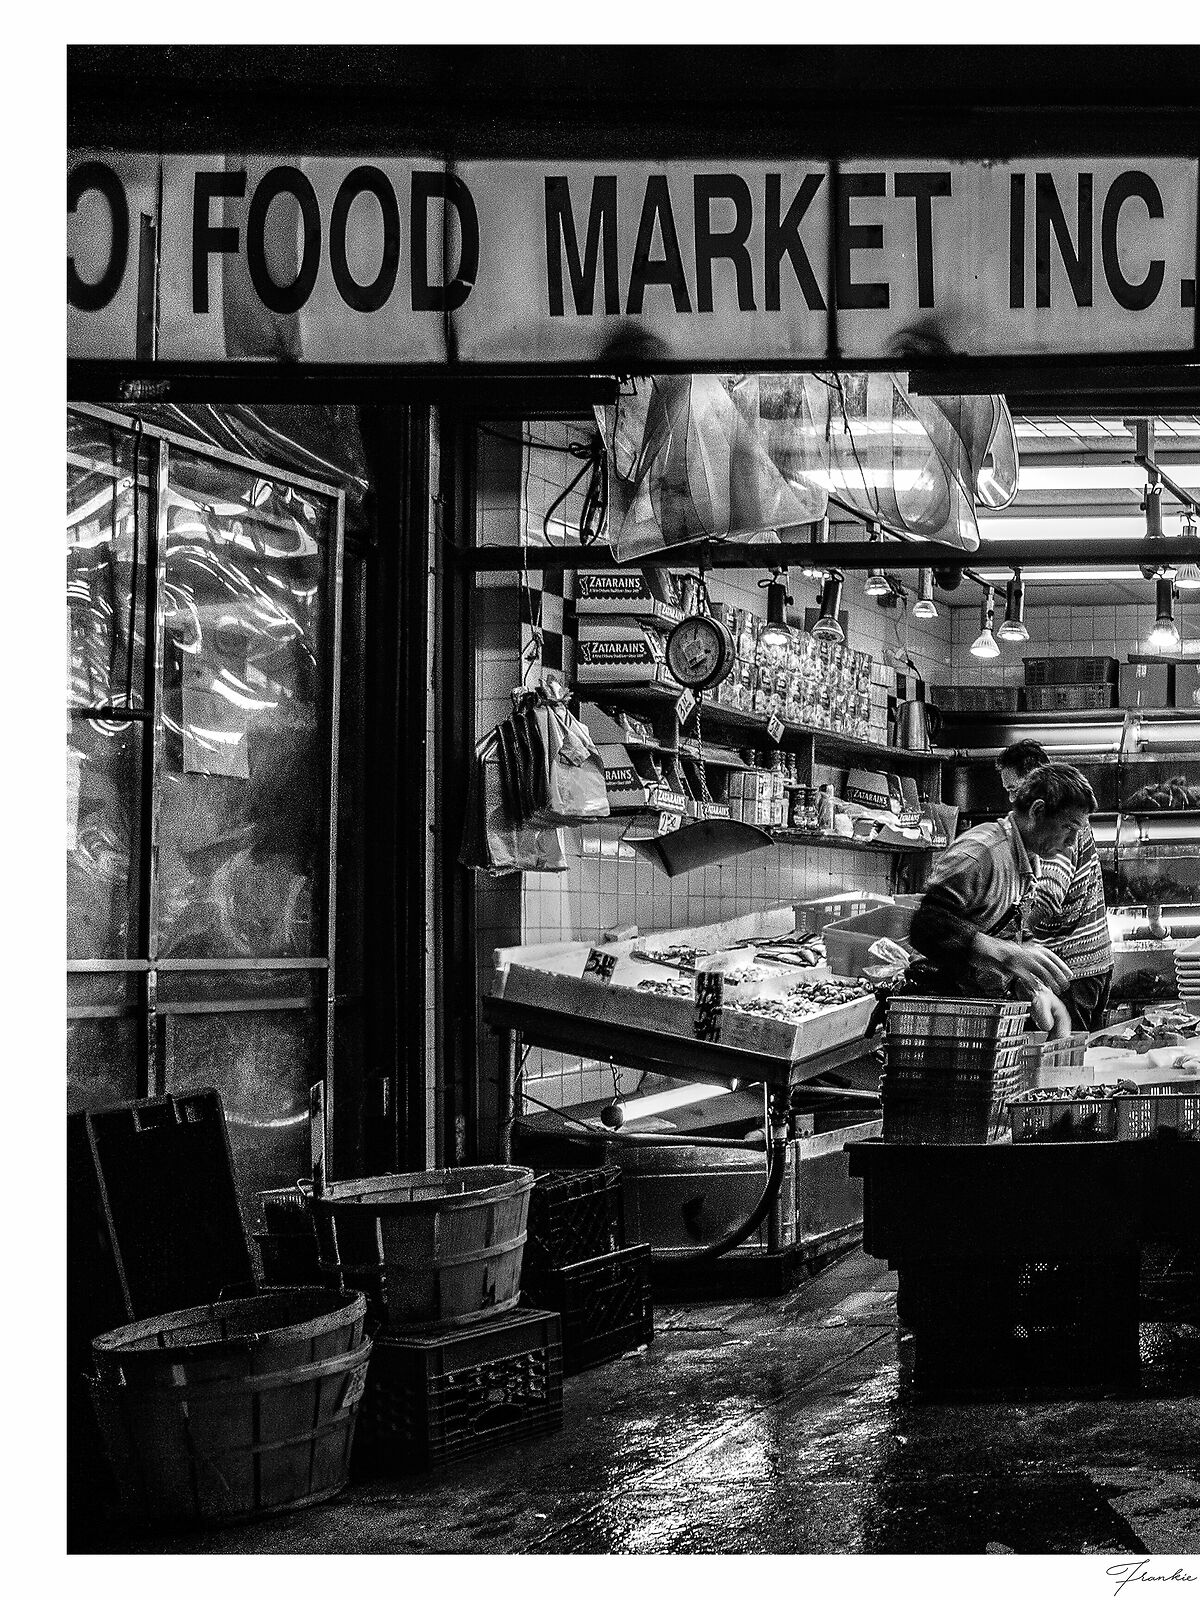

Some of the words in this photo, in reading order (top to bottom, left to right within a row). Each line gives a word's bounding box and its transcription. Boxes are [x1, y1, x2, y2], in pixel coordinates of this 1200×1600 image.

[192, 165, 480, 314] FOOD
[544, 171, 952, 317] MARKET
[1009, 170, 1196, 312] INC.
